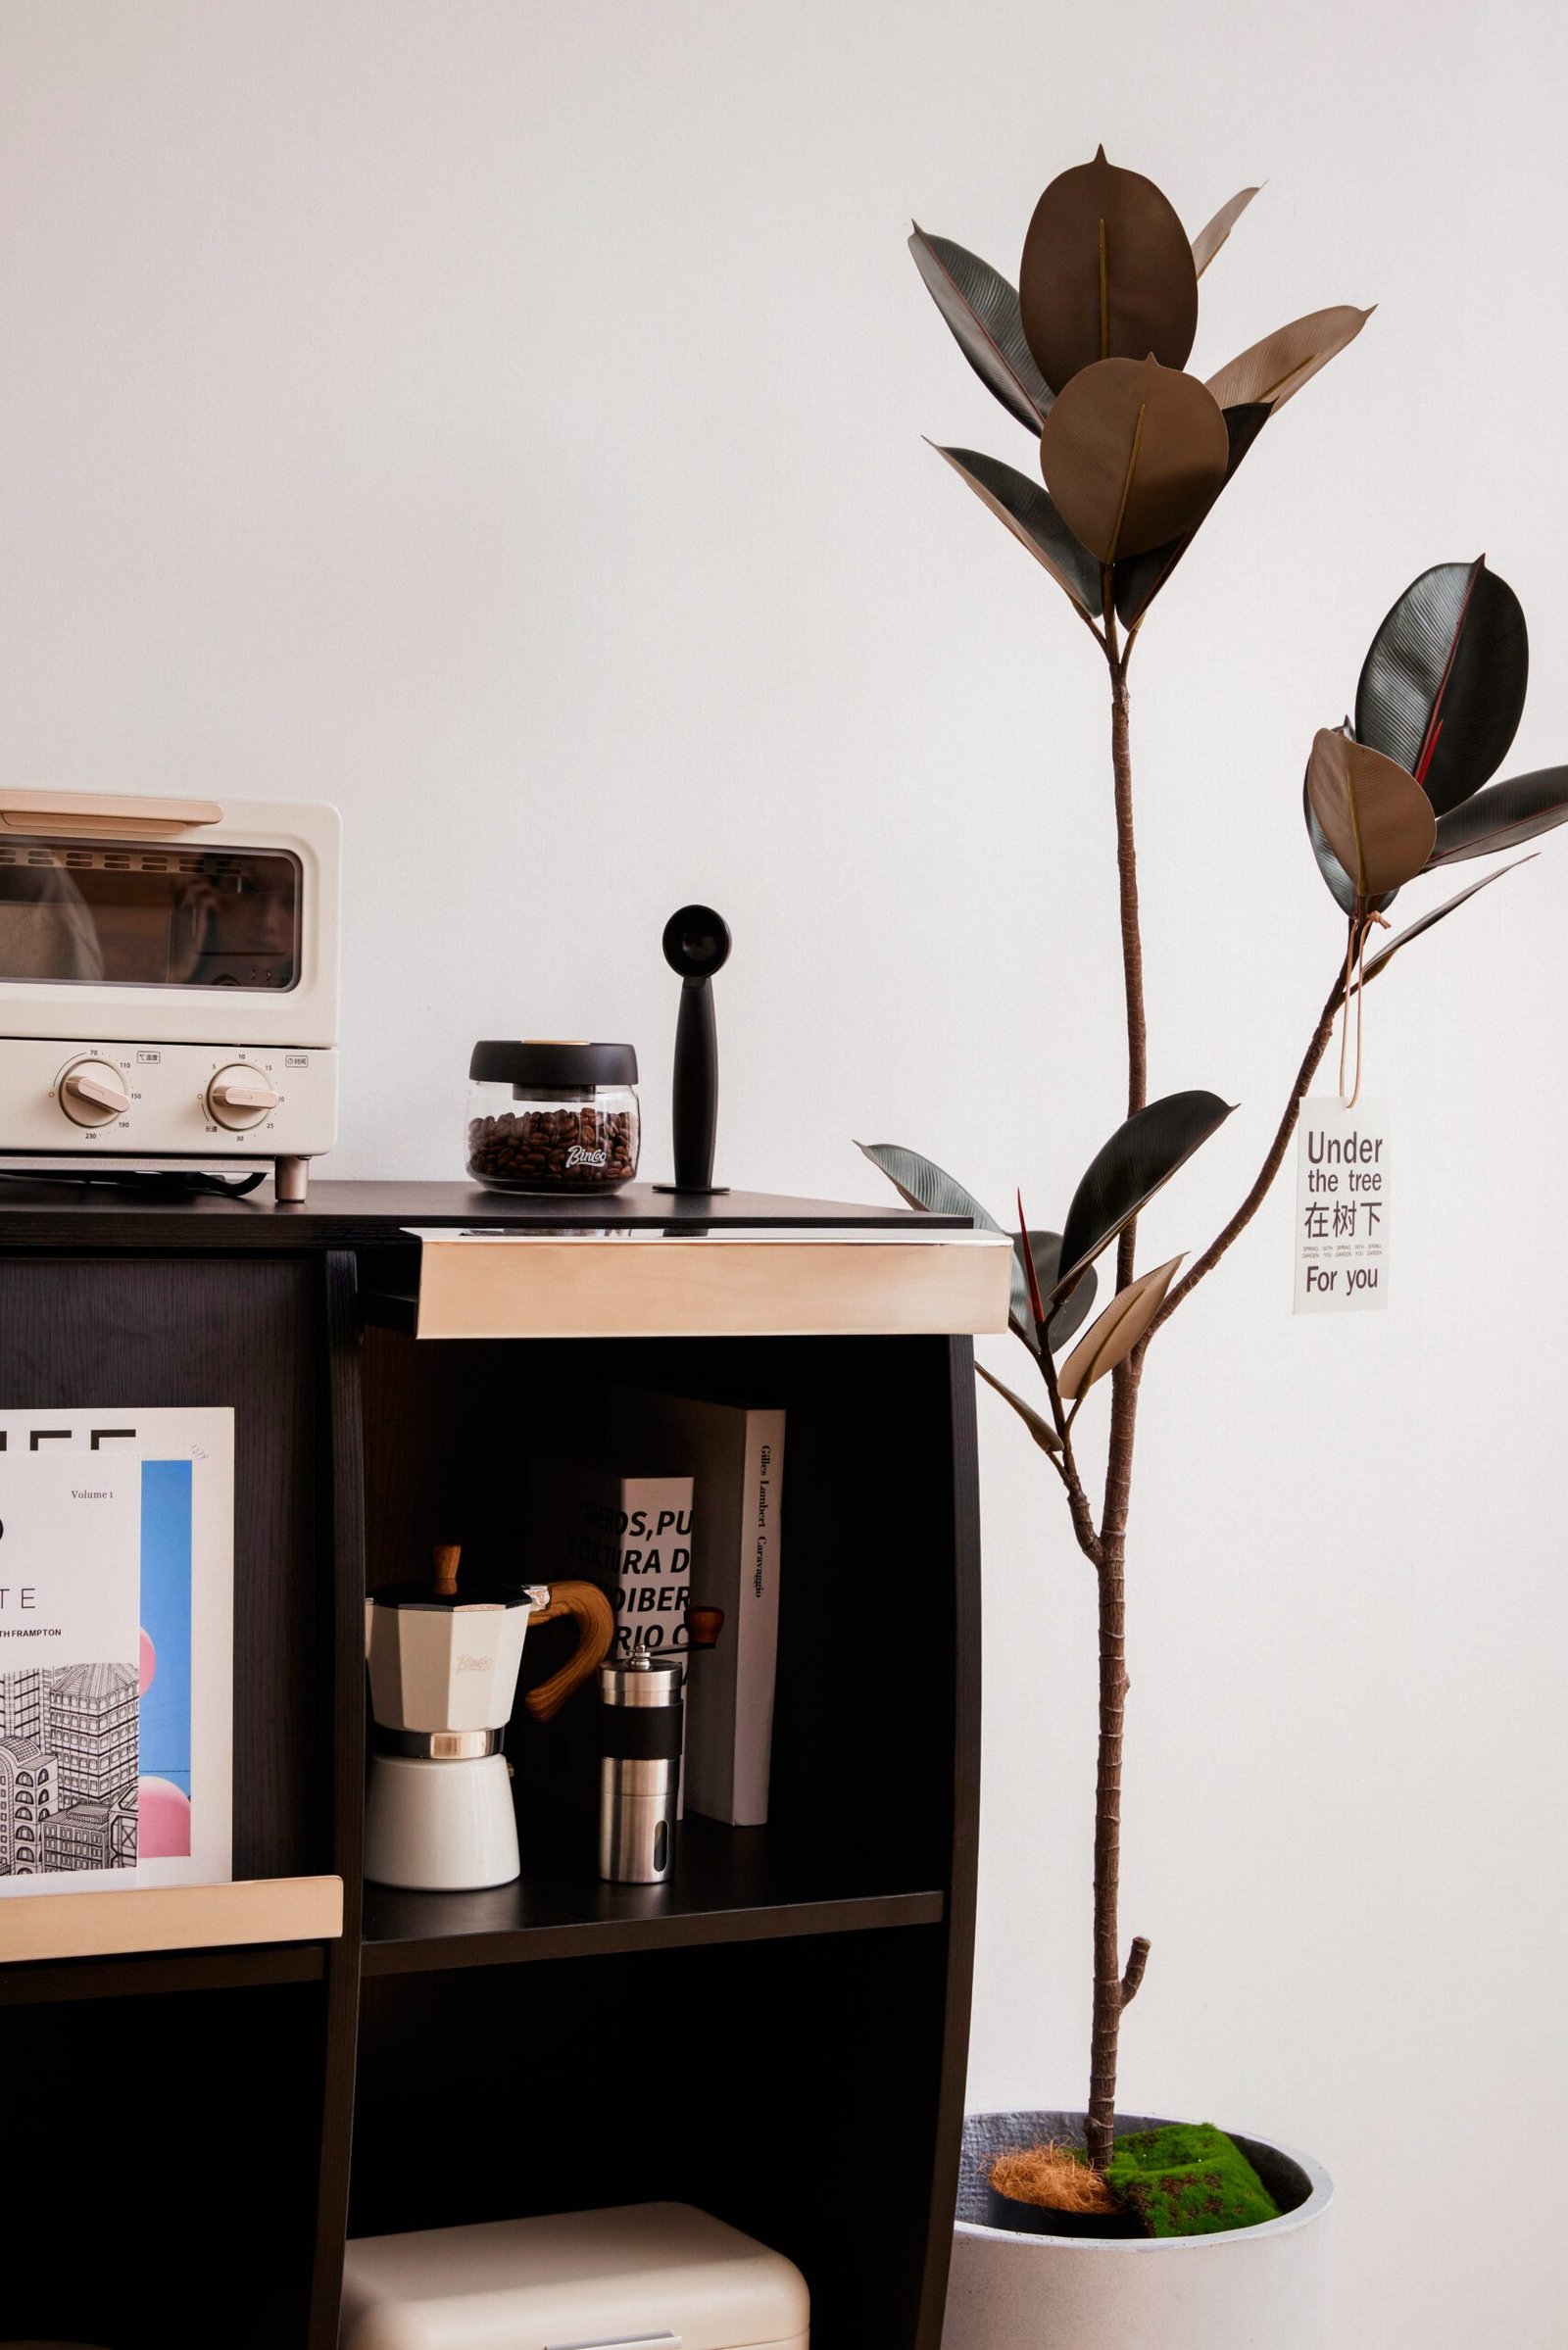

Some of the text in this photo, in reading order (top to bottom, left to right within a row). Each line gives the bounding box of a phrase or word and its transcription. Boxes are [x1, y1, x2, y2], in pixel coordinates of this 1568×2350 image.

[1308, 1131, 1383, 1164] Under
[1308, 1169, 1382, 1193] the tree
[1304, 1200, 1383, 1239] 在树下
[1306, 1265, 1378, 1297] For you
[72, 1490, 108, 1499] Volume
[754, 1444, 771, 1598] Gilles Lambert Caravaggio
